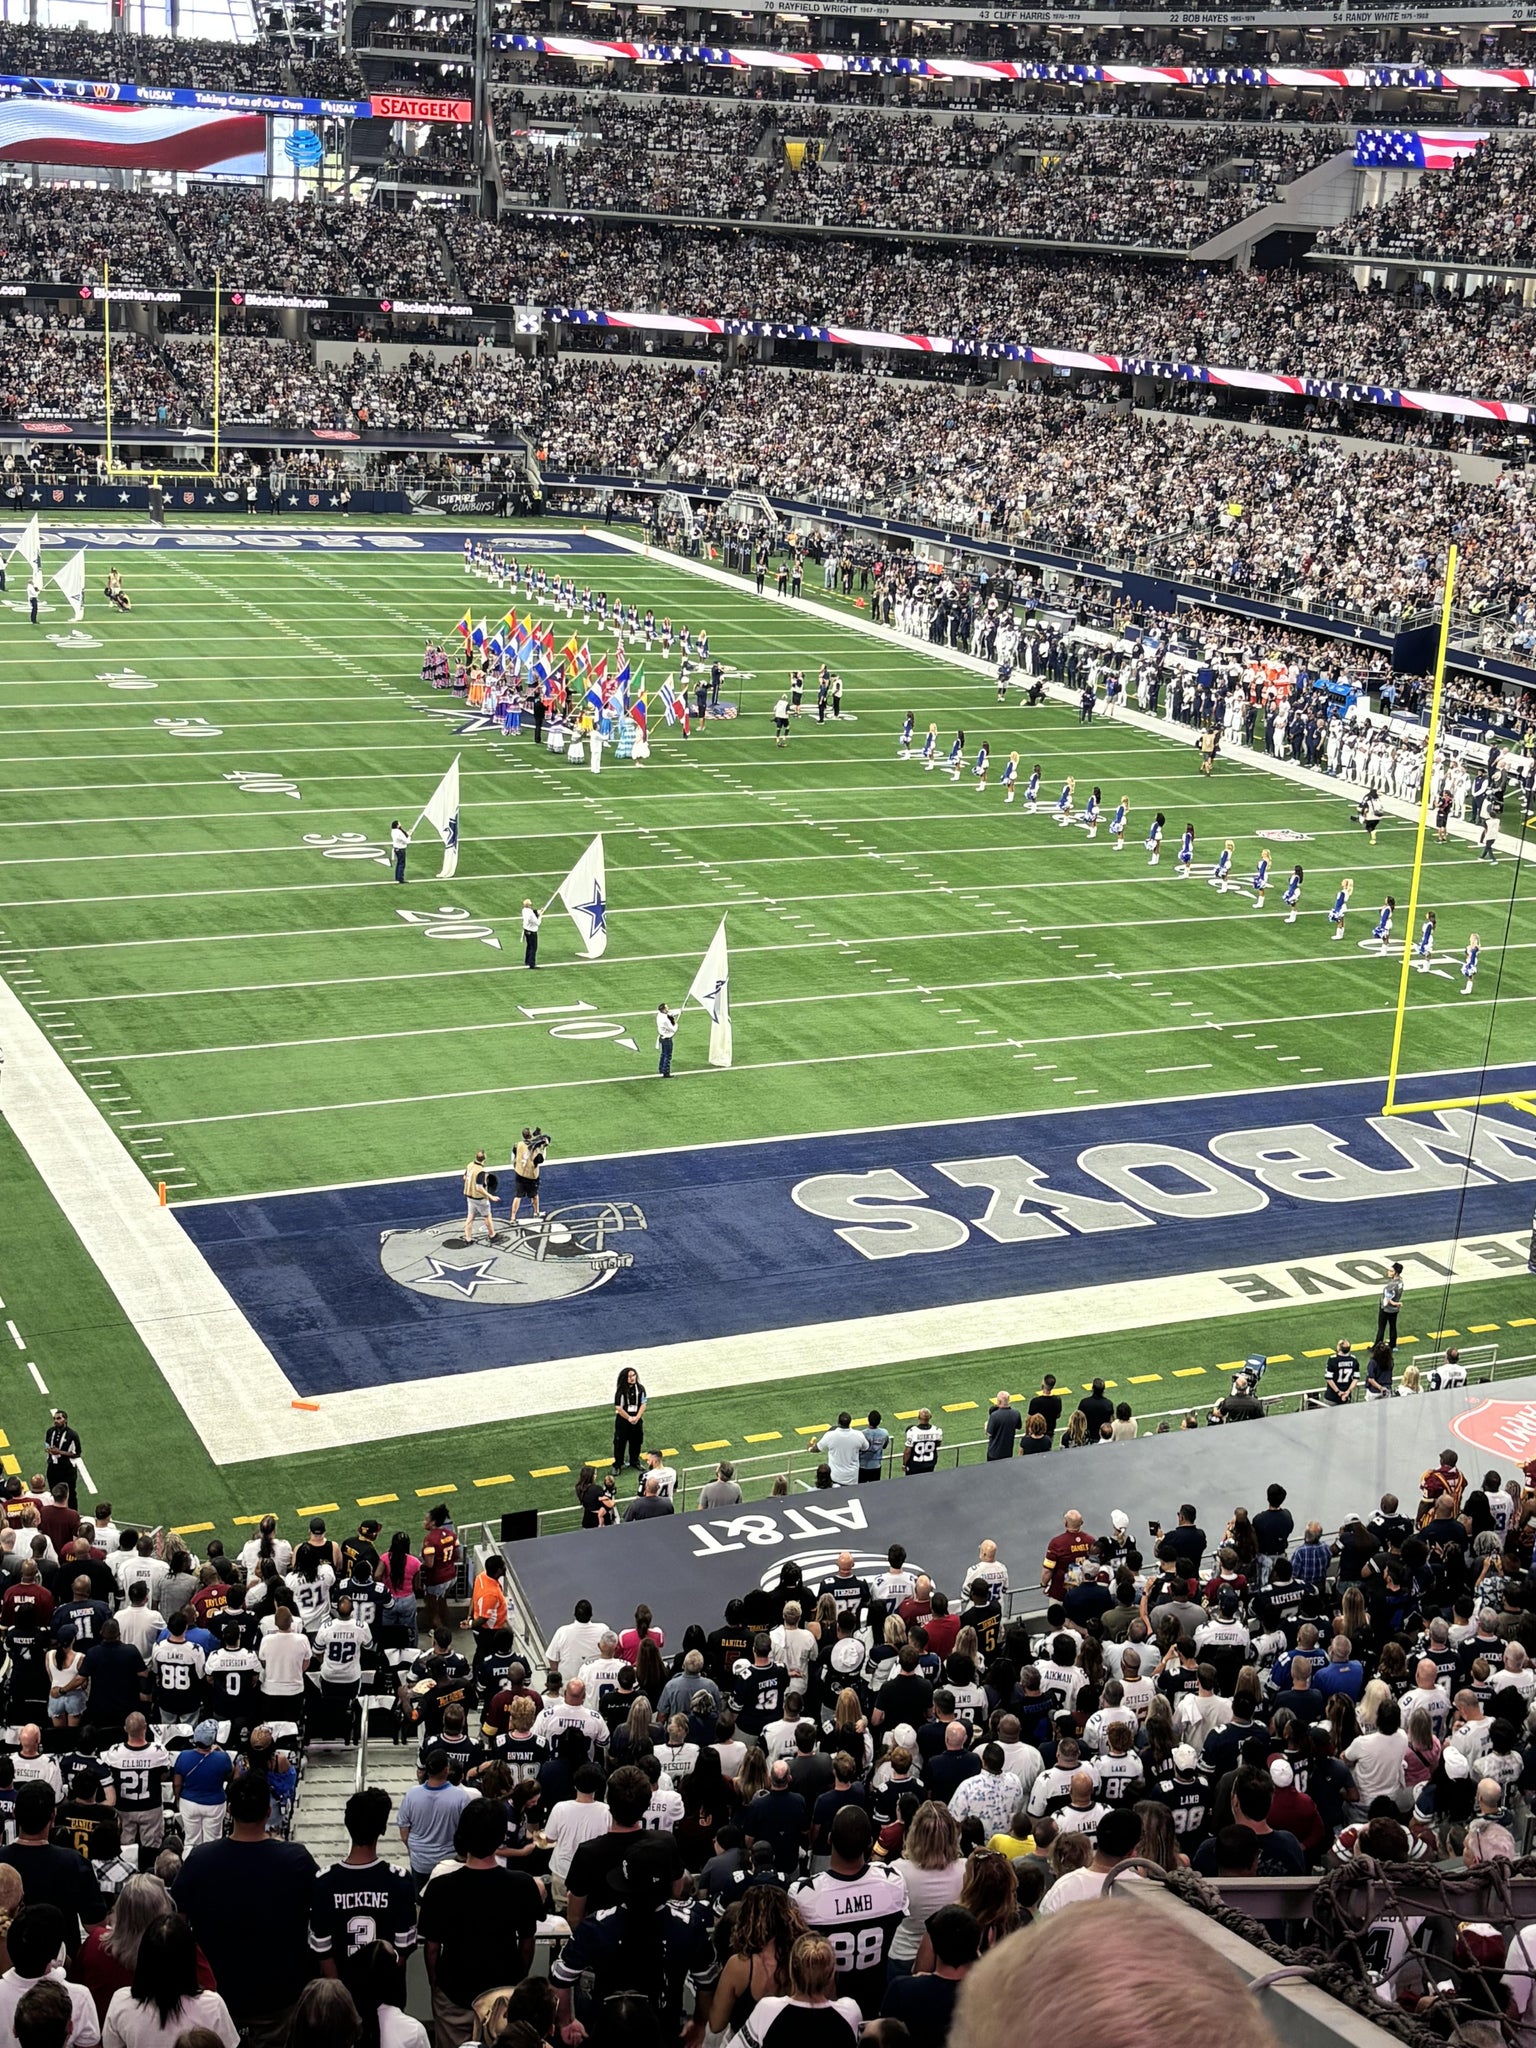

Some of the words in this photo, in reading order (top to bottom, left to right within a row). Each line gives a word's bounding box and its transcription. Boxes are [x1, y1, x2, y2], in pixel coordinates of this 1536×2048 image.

[764, 1, 775, 10] 70
[778, 2, 820, 12] RAYFIELD
[822, 5, 858, 14] WRIGHT
[979, 10, 990, 19] 43
[993, 11, 1018, 20] CLIFF
[1019, 12, 1051, 20] HARRIS
[1511, 9, 1523, 18] 20
[1169, 14, 1179, 23] 22
[1182, 14, 1200, 23] BOB
[1202, 14, 1229, 23] HAYES
[1333, 13, 1343, 22] 54
[1345, 13, 1372, 22] RANDY
[1374, 12, 1399, 21] WHITE
[76, 82, 85, 96] 0
[149, 89, 174, 101] USAA
[195, 92, 228, 107] Taking
[228, 95, 250, 107] Care
[251, 98, 263, 107] of
[263, 98, 281, 109] Our
[282, 100, 303, 110] Own
[332, 102, 355, 114] USAA
[380, 98, 459, 119] SEATGEEK
[93, 287, 181, 302] Blockchain.com
[244, 294, 329, 309] Blockchain.com
[393, 301, 473, 316] Blockchain.com
[303, 831, 387, 861] 30
[395, 906, 494, 940] 20
[516, 1000, 626, 1040] 10
[1218, 1251, 1459, 1303] LOVE
[1336, 1368, 1353, 1383] 17
[913, 1441, 936, 1463] 99
[688, 1498, 869, 1557] AT&T
[203, 1596, 228, 1609] TAYLOR
[300, 1587, 325, 1610] 21
[74, 1616, 94, 1641] 11
[720, 1638, 747, 1648] DANIELS
[985, 1630, 997, 1653] 5
[327, 1641, 357, 1664] 82
[160, 1663, 191, 1690] 88
[225, 1671, 241, 1697] 0
[1044, 1669, 1073, 1684] AIKMAN
[1125, 1693, 1150, 1706] STYLES
[507, 1750, 535, 1761] BRYANT
[121, 1759, 152, 1769] ELLIOTT
[119, 1769, 150, 1801] 21
[1179, 1794, 1200, 1805] LAMB
[333, 1891, 389, 1909] PICKENS
[834, 1894, 874, 1916] LAMB
[832, 1927, 884, 1973] 88
